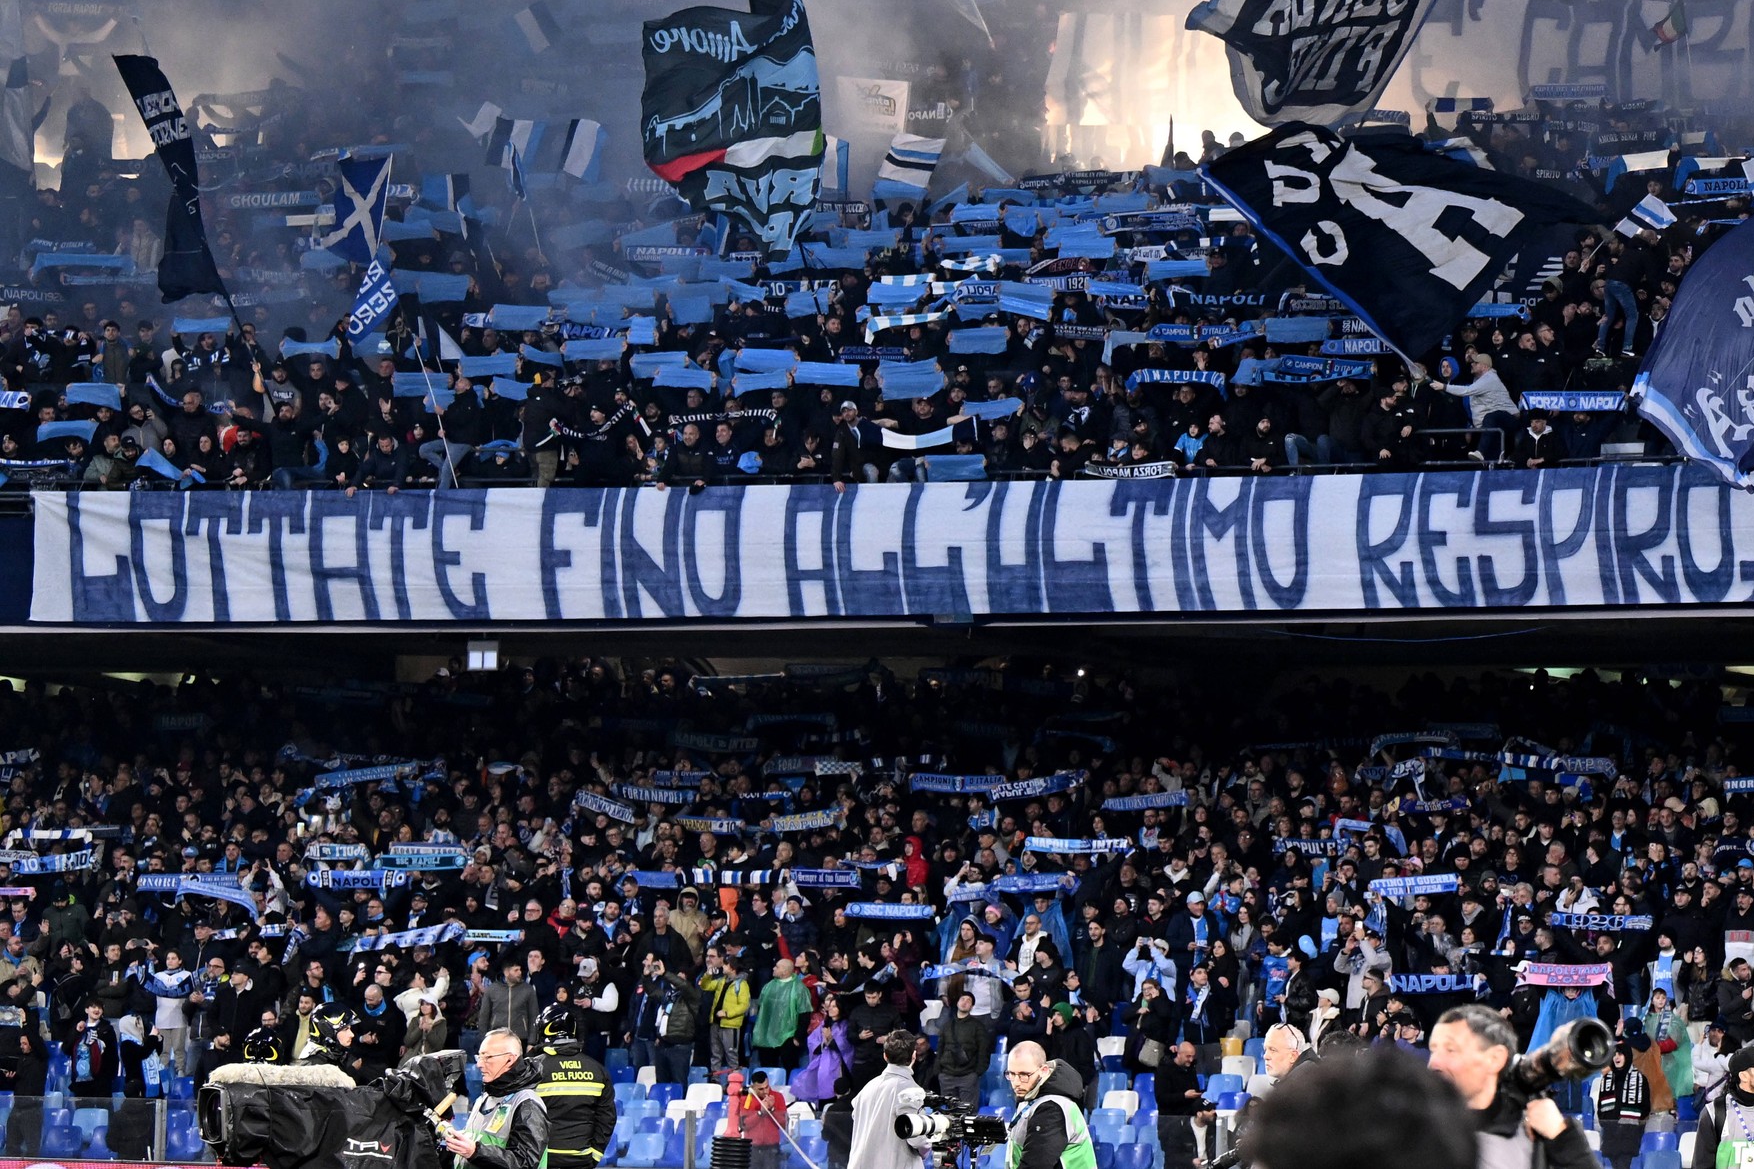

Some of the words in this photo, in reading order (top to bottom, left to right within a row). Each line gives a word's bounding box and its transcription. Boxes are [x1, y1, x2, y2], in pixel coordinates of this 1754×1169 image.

[1471, 112, 1497, 121] SPIRITO
[1515, 112, 1540, 121] LIBERO
[1535, 169, 1561, 180] SPIRITO
[1703, 177, 1749, 191] NAPOLI
[230, 192, 301, 208] GHOULAM
[635, 247, 690, 256] NAPOLI
[770, 282, 785, 297] 10
[1190, 292, 1266, 307] NAPOLI
[1162, 326, 1190, 337] CAMPIONI
[1201, 325, 1231, 336] D'ITALIA
[1344, 339, 1380, 353] NAPOLI
[1294, 360, 1324, 371] CAMPIONI
[1152, 369, 1208, 382] NAPOLI
[1526, 394, 1566, 412] FORZA
[1579, 394, 1623, 412] NAPOLI
[668, 413, 713, 426] Rione
[66, 487, 488, 622] LOTTATE
[541, 484, 743, 619] FINO
[784, 471, 1311, 617] ALL'ULTIMO
[728, 737, 759, 750] INTER
[913, 777, 951, 785] CAMPIONI
[968, 776, 1004, 785] D'ITALIA
[622, 786, 649, 802] FORZA
[650, 789, 684, 804] NAPOLI
[1125, 796, 1146, 809] TORNA
[1031, 836, 1069, 849] NAPOLI
[1091, 838, 1128, 850] INTER
[21, 856, 39, 872] 10
[74, 853, 88, 868] 10
[396, 857, 408, 866] SSC
[411, 856, 441, 867] NAPOLI
[343, 869, 371, 878] FORZA
[796, 872, 818, 884] Sempre
[1405, 877, 1416, 887] DI
[1416, 872, 1457, 886] GUERRA
[331, 876, 384, 888] NAPOLI
[1387, 885, 1404, 896] TUA
[1414, 883, 1443, 895] DIFESA
[862, 903, 885, 915] SSC
[885, 903, 922, 917] NAPOLI
[1562, 914, 1624, 930] 1926
[936, 963, 955, 976] 10
[1528, 964, 1609, 976] NAPOLETANA
[1391, 973, 1475, 994] NAPOLI
[559, 1060, 582, 1070] VIGILI
[551, 1071, 568, 1081] DEL
[568, 1070, 594, 1081] FUOCO
